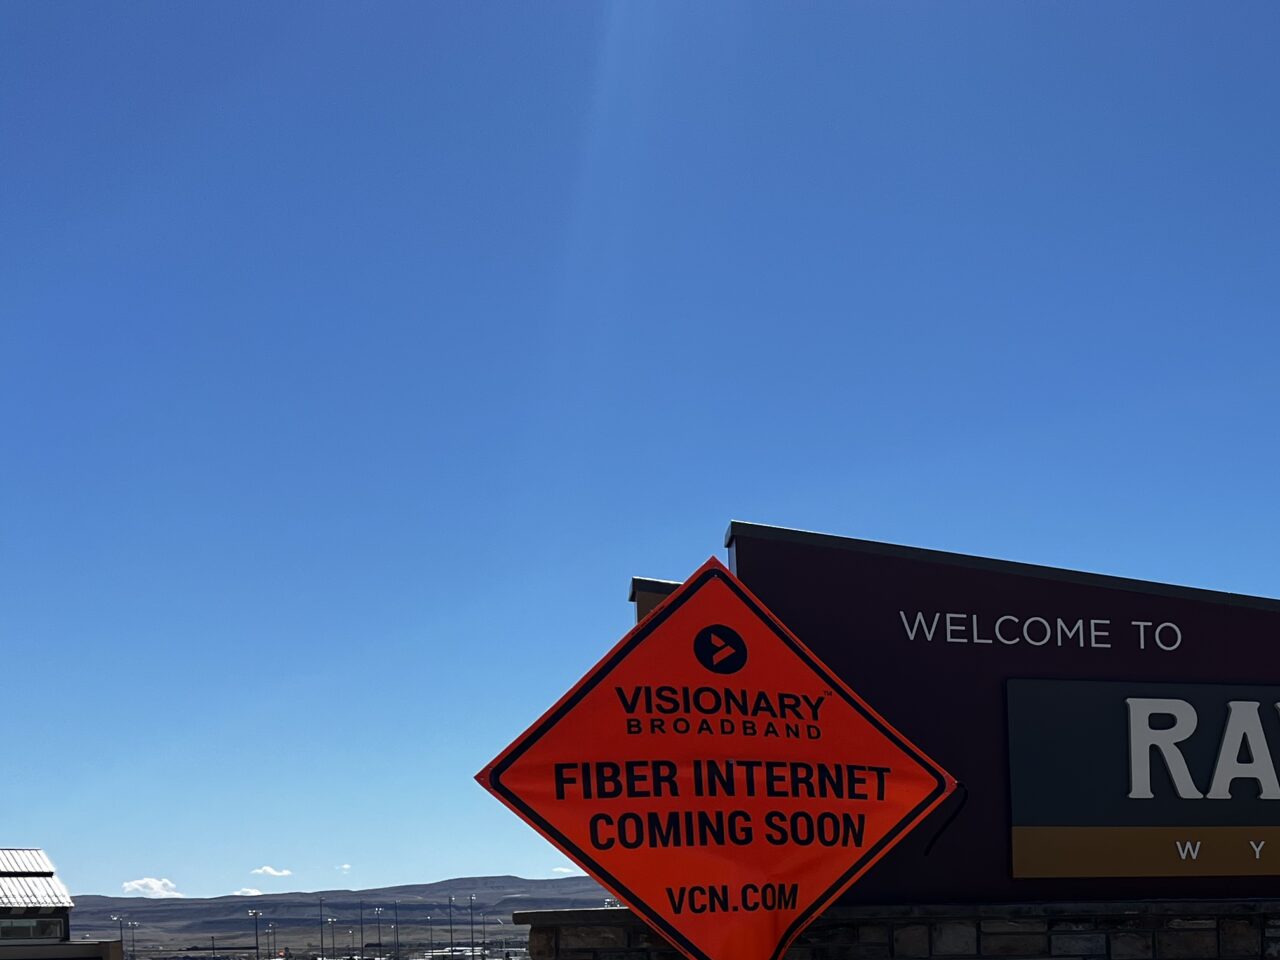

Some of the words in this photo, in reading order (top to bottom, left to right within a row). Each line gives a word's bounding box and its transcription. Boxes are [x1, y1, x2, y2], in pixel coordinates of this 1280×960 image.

[899, 610, 1112, 649] WELCOME
[1131, 619, 1183, 652] TO
[616, 686, 825, 721] VISIONARY
[627, 717, 822, 740] BROADBAND
[554, 760, 679, 801] FIBER
[694, 759, 892, 801] INTERNET
[589, 811, 754, 850] COMING
[765, 812, 866, 848] SOON
[666, 883, 799, 914] VCN.COM
